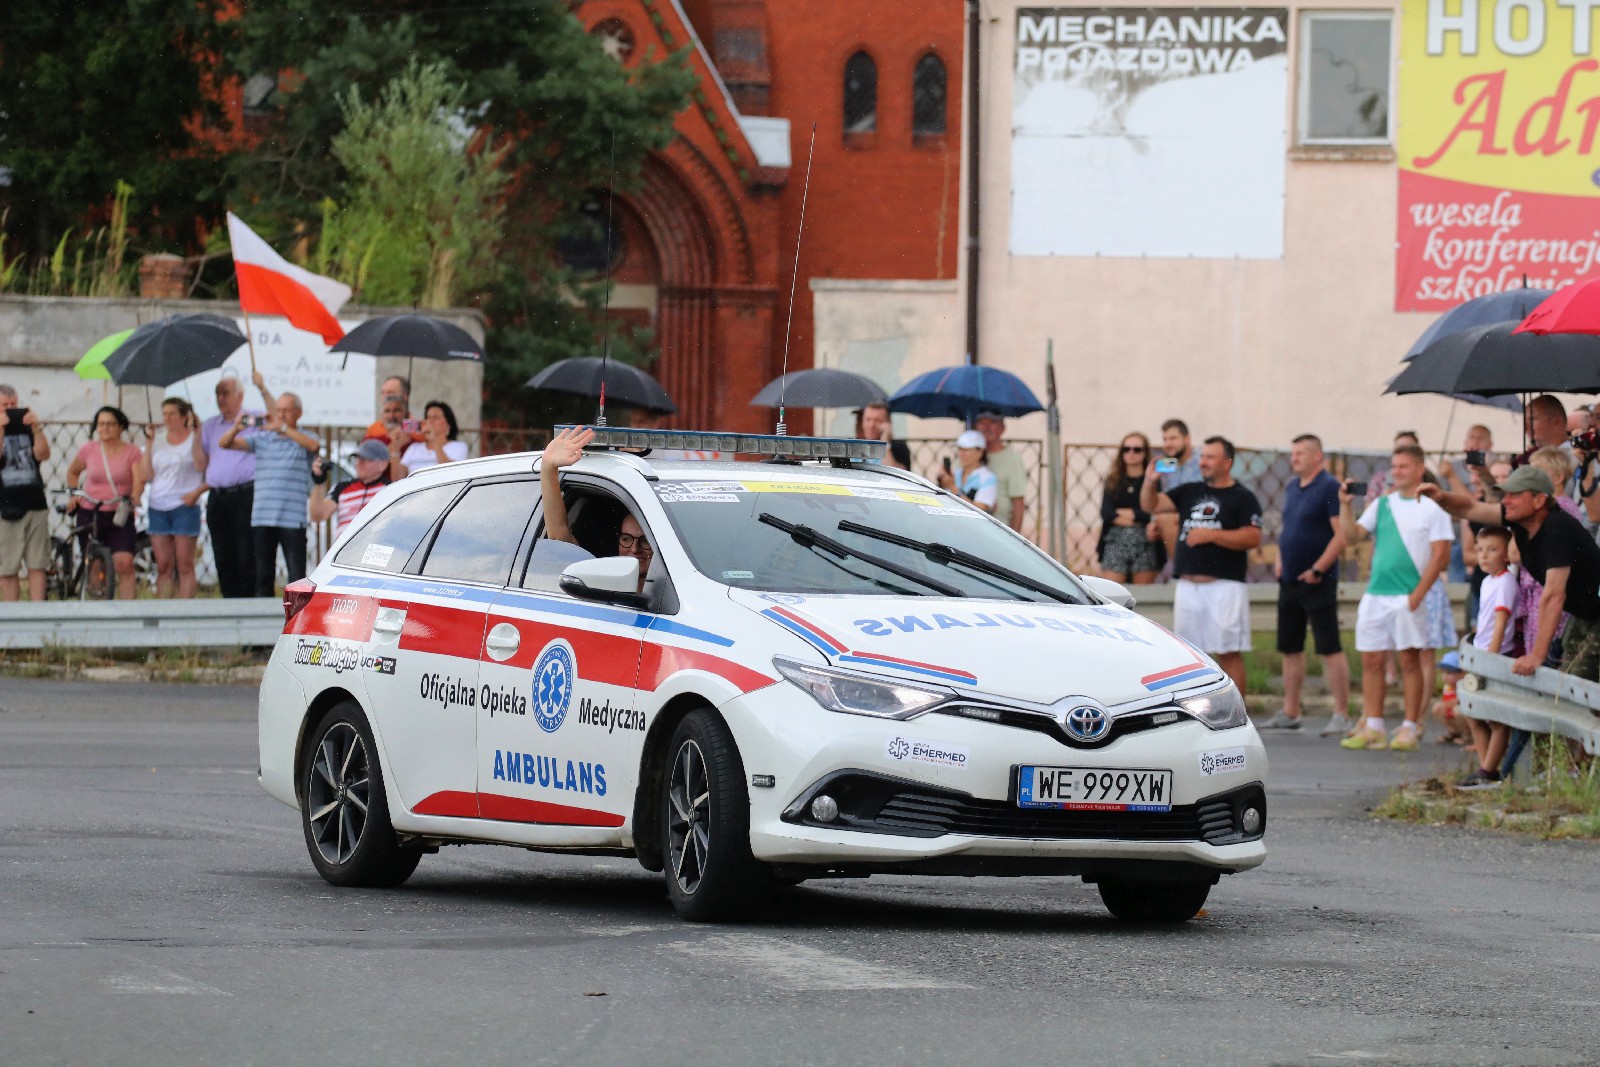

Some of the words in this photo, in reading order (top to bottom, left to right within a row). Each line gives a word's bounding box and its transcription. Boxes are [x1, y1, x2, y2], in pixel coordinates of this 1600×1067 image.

[1018, 15, 1287, 43] MECHANIKA
[1409, 192, 1522, 227] wesela
[1422, 225, 1600, 275] konferencj
[420, 673, 476, 709] Oficjalna
[480, 684, 527, 718] Opieka
[578, 697, 646, 734] Medyczna
[912, 747, 966, 762] EMERMED
[1215, 755, 1245, 767] EMERMED
[493, 750, 607, 797] AMBULANS
[1021, 787, 1031, 797] PL
[1039, 770, 1073, 799] WE
[1083, 772, 1165, 802] 999XW
